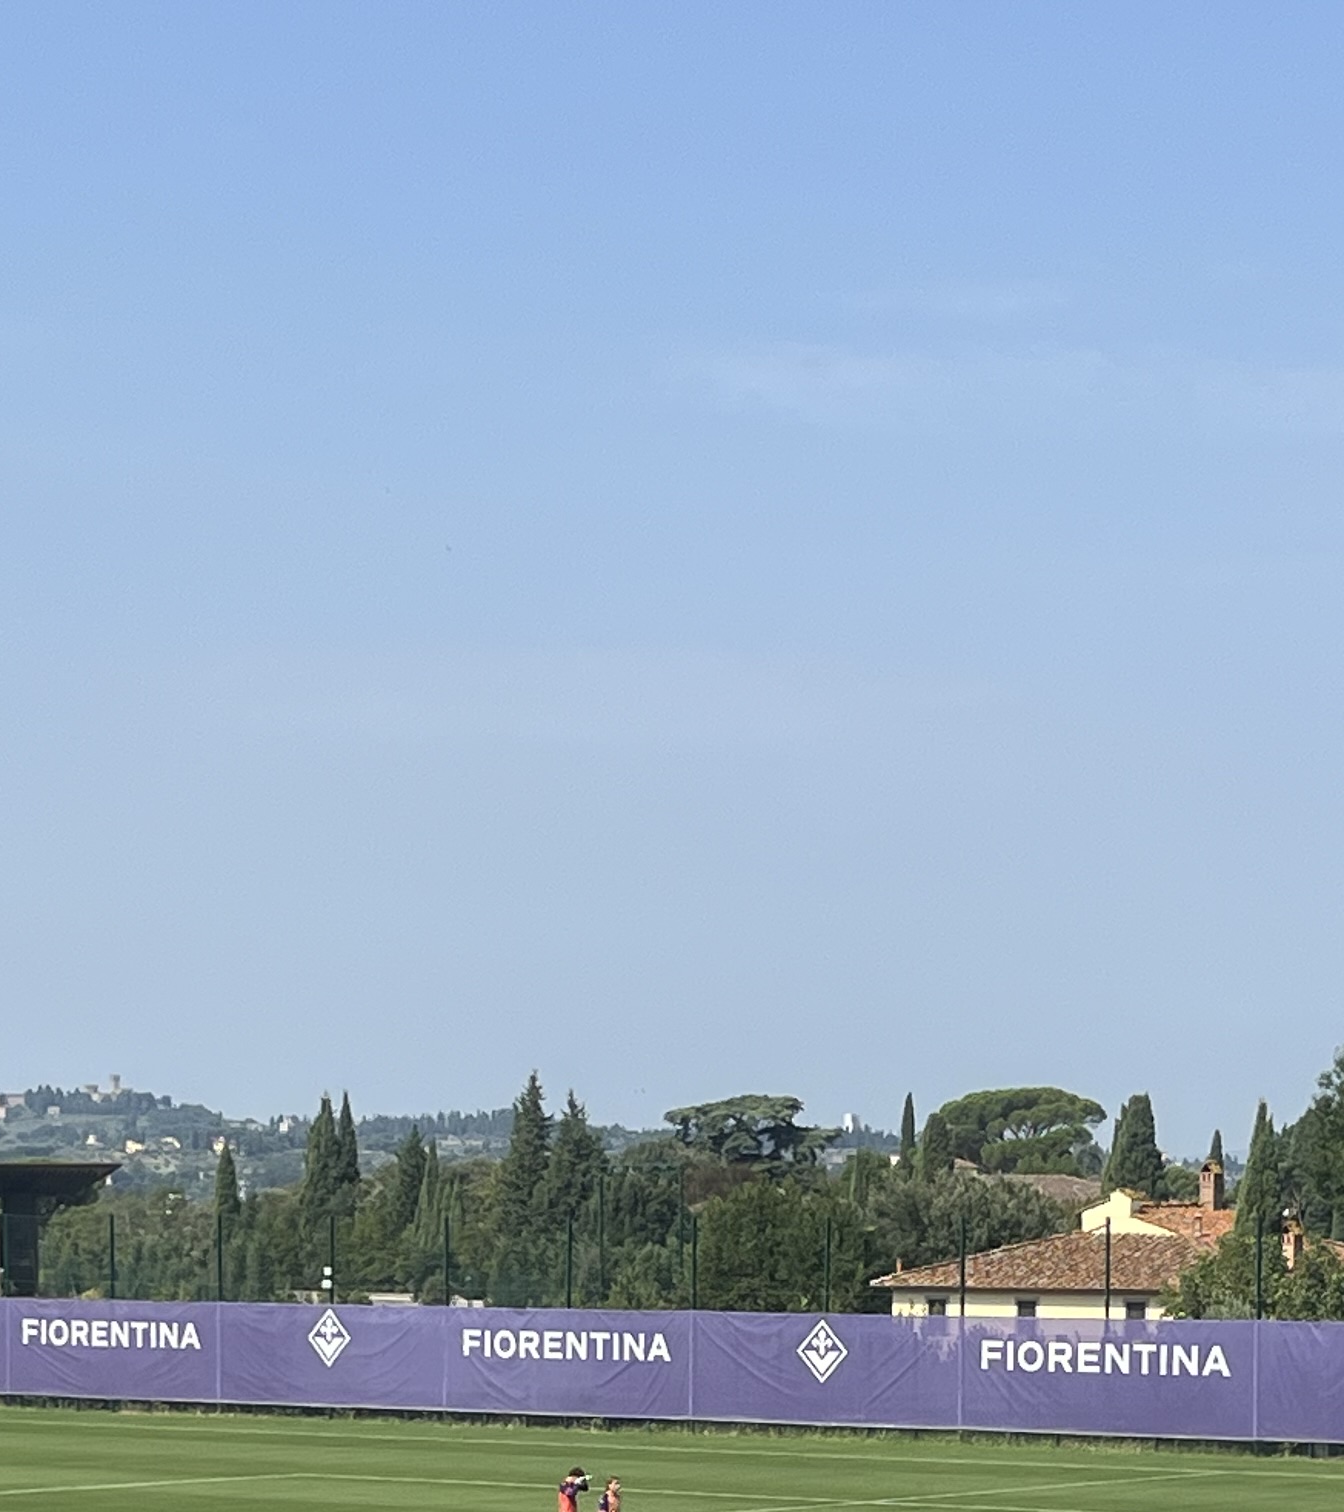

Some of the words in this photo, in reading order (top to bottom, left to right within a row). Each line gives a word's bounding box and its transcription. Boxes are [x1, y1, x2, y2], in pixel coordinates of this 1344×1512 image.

[21, 1318, 201, 1350] FIORENTINA
[462, 1328, 671, 1362] FIORENTINA
[979, 1339, 1231, 1378] FIORENTINA
